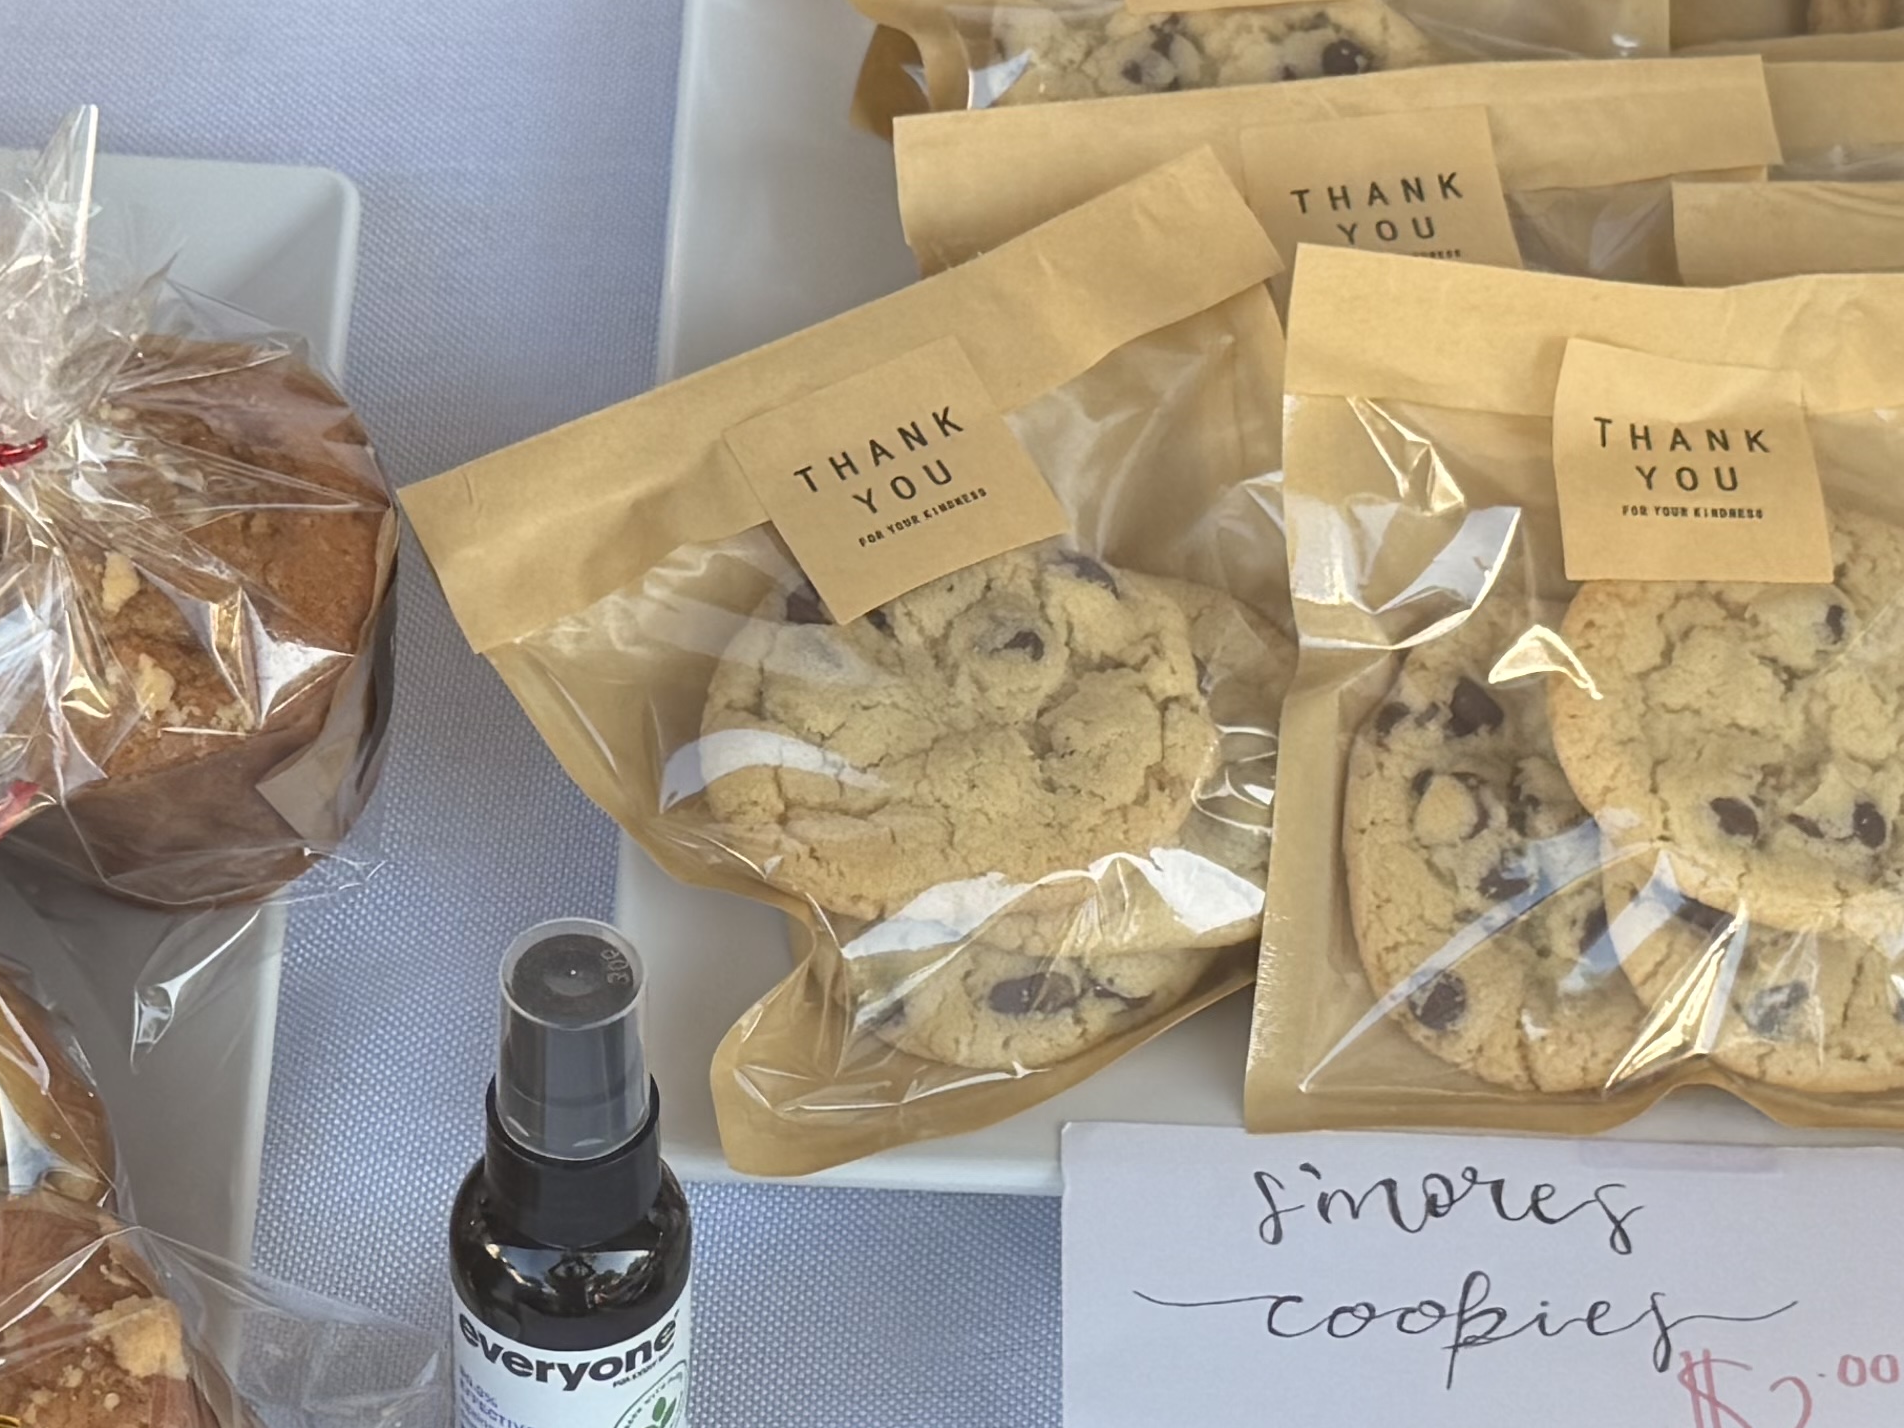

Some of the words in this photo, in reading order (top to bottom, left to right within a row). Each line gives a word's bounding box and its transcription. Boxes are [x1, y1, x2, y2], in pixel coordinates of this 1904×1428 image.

[1290, 172, 1463, 215] THANK
[1337, 216, 1436, 246] YOU
[793, 406, 964, 493] THANK
[1593, 416, 1771, 453] THANK
[852, 459, 953, 515] YOU
[1635, 465, 1739, 491] YOU
[858, 530, 885, 548] FOR
[887, 515, 921, 535] YOUR
[923, 487, 987, 521] KINDNESS
[1622, 505, 1648, 517] FOR
[1654, 506, 1689, 518] YOUR
[1693, 507, 1764, 520] KINDNESS
[459, 1313, 677, 1391] everyone
